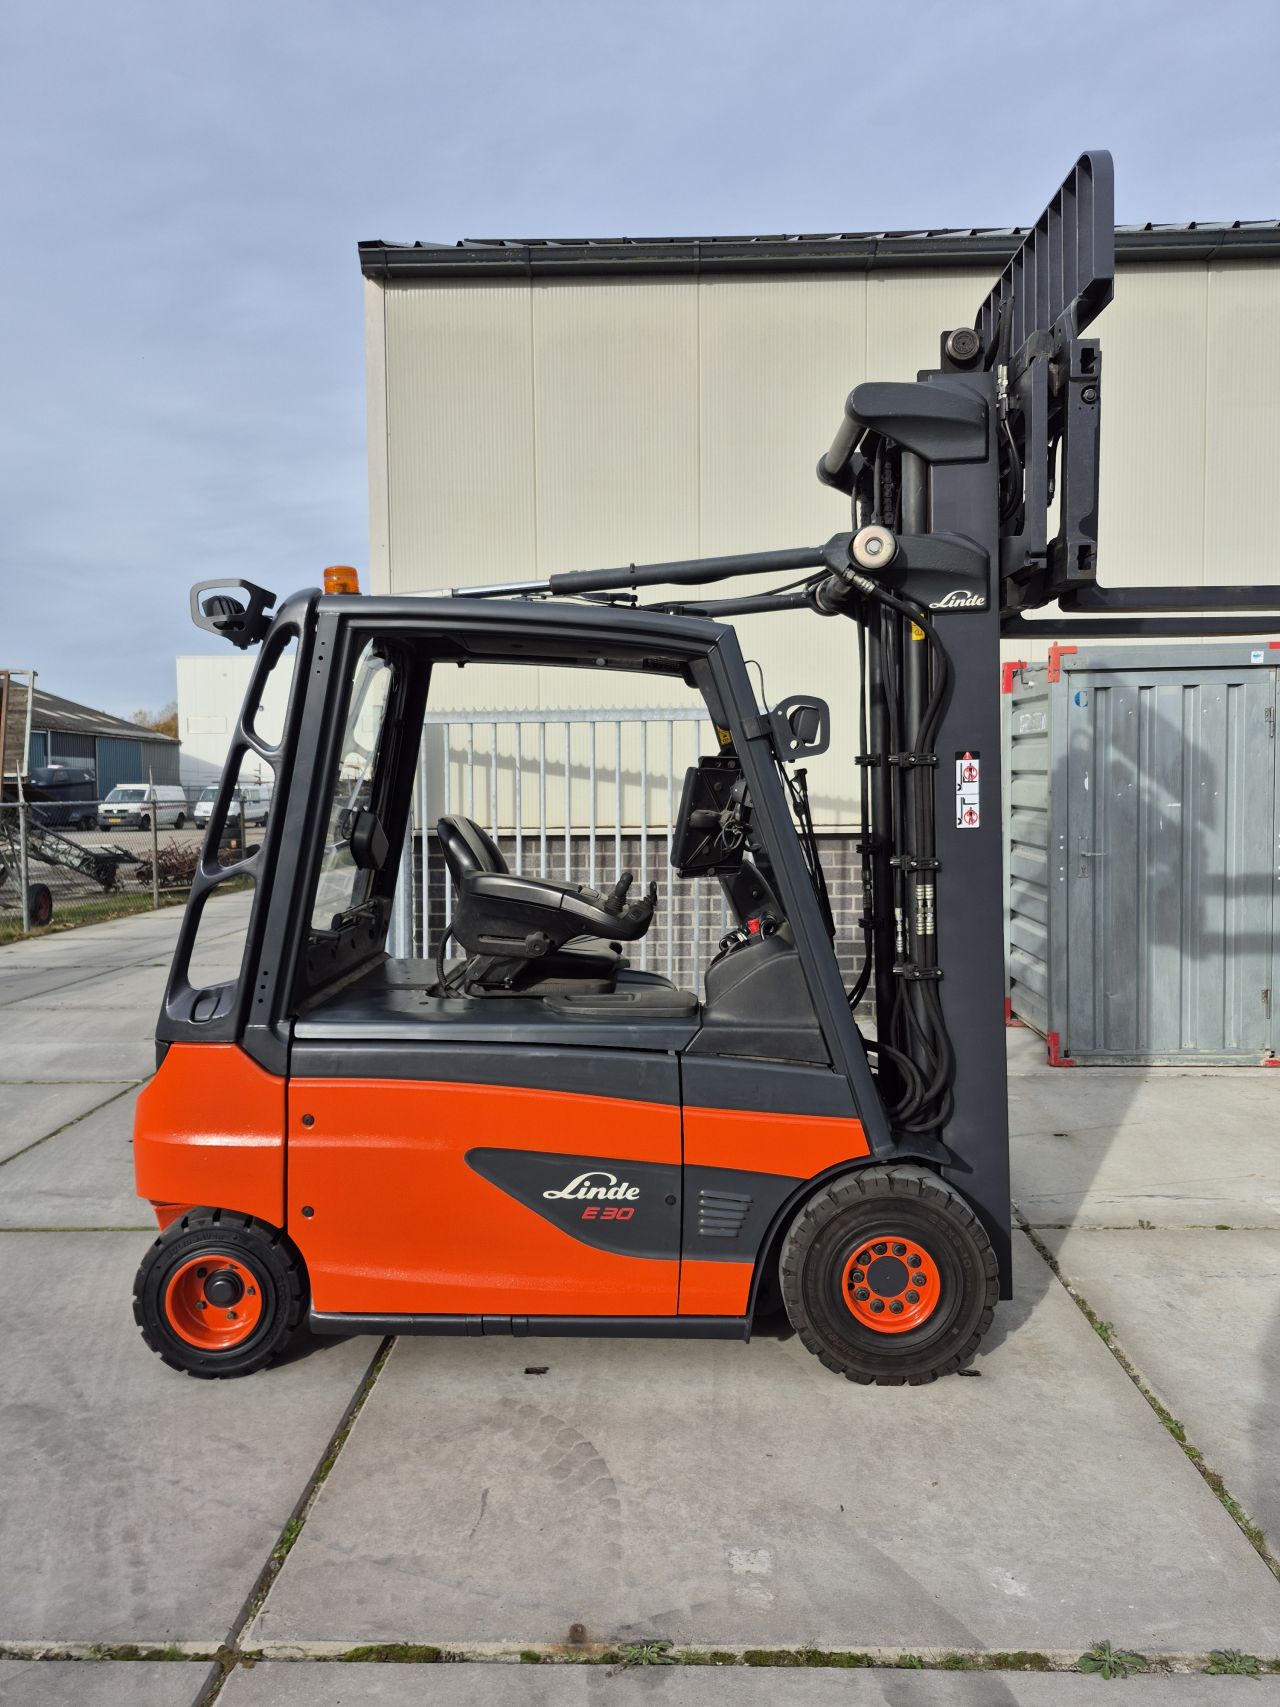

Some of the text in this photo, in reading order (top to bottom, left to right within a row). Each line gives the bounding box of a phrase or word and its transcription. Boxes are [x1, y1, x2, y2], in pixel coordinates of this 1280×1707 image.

[928, 590, 985, 608] Linde
[542, 1171, 640, 1201] Linde
[581, 1206, 635, 1220] E 30
